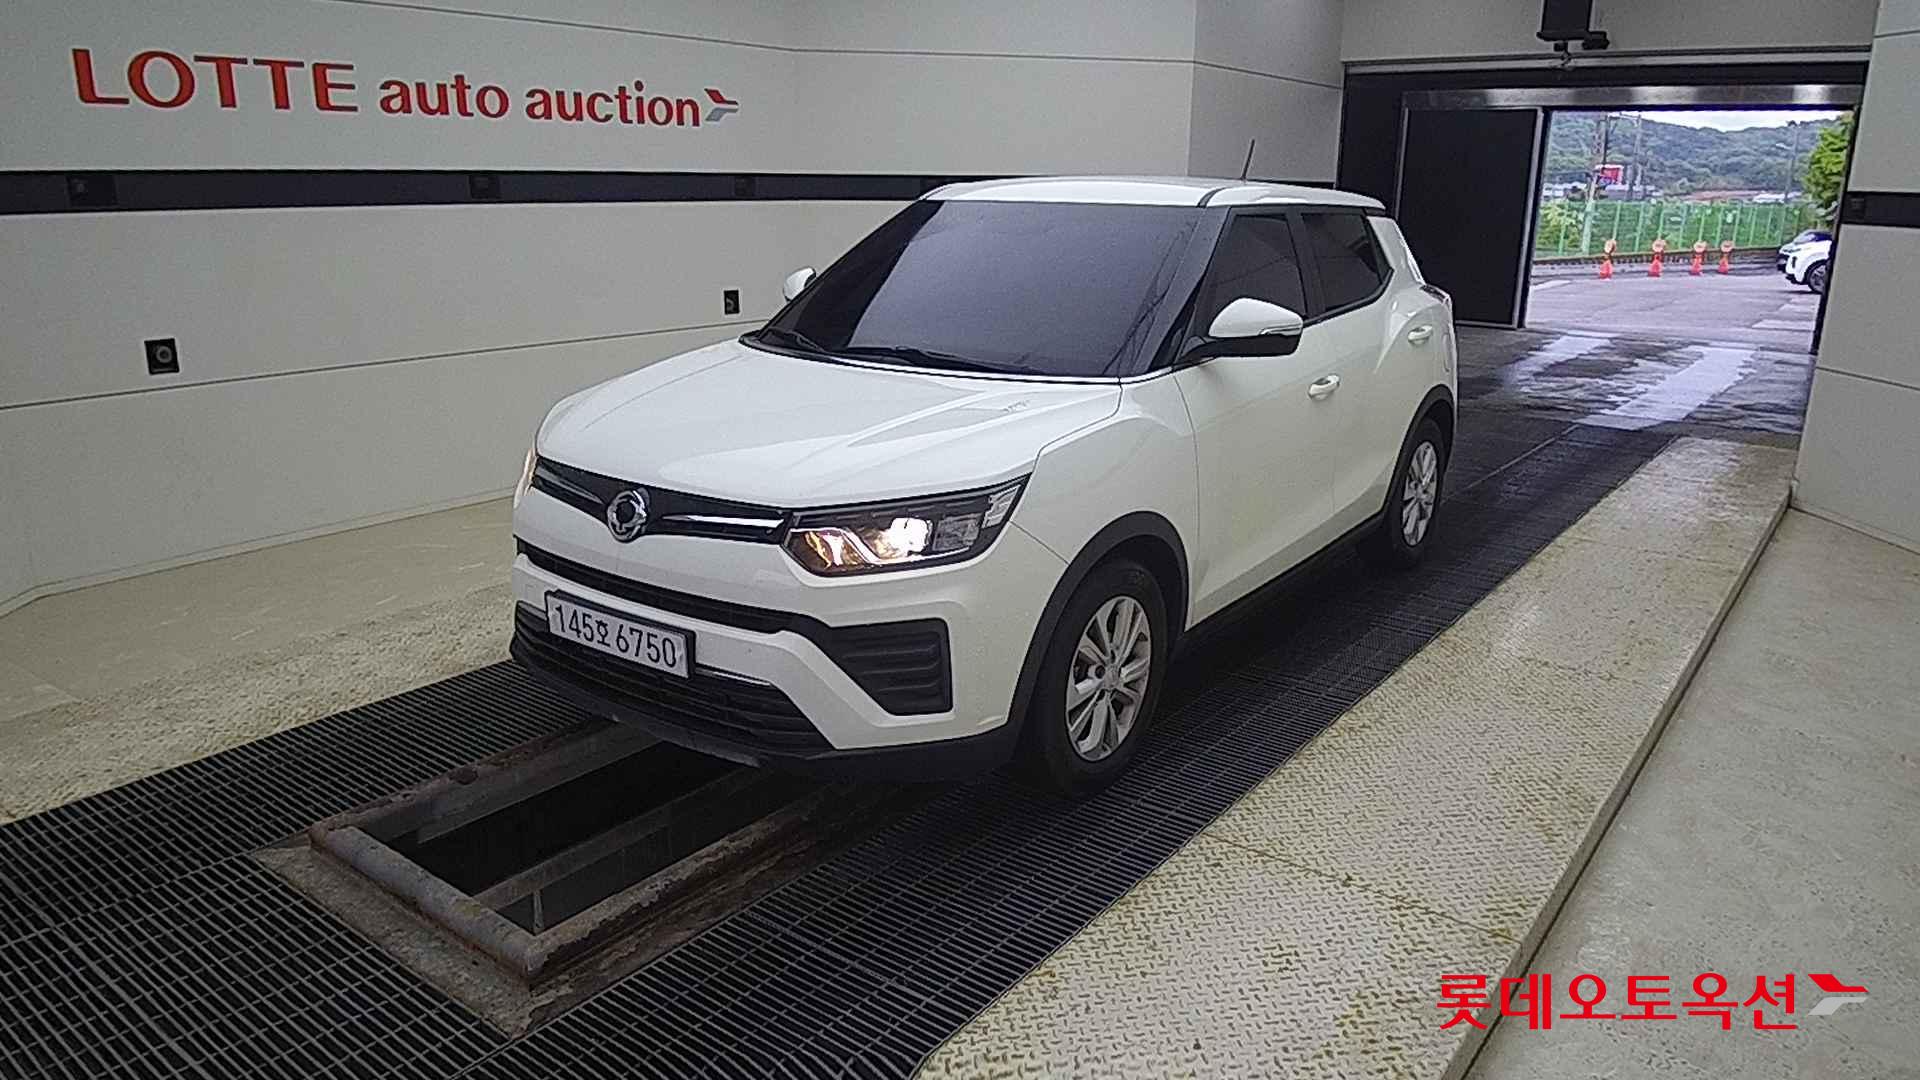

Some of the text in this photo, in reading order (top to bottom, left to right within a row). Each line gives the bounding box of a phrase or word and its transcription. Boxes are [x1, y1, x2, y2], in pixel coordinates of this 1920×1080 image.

[72, 48, 700, 127] LOTTE auto auction
